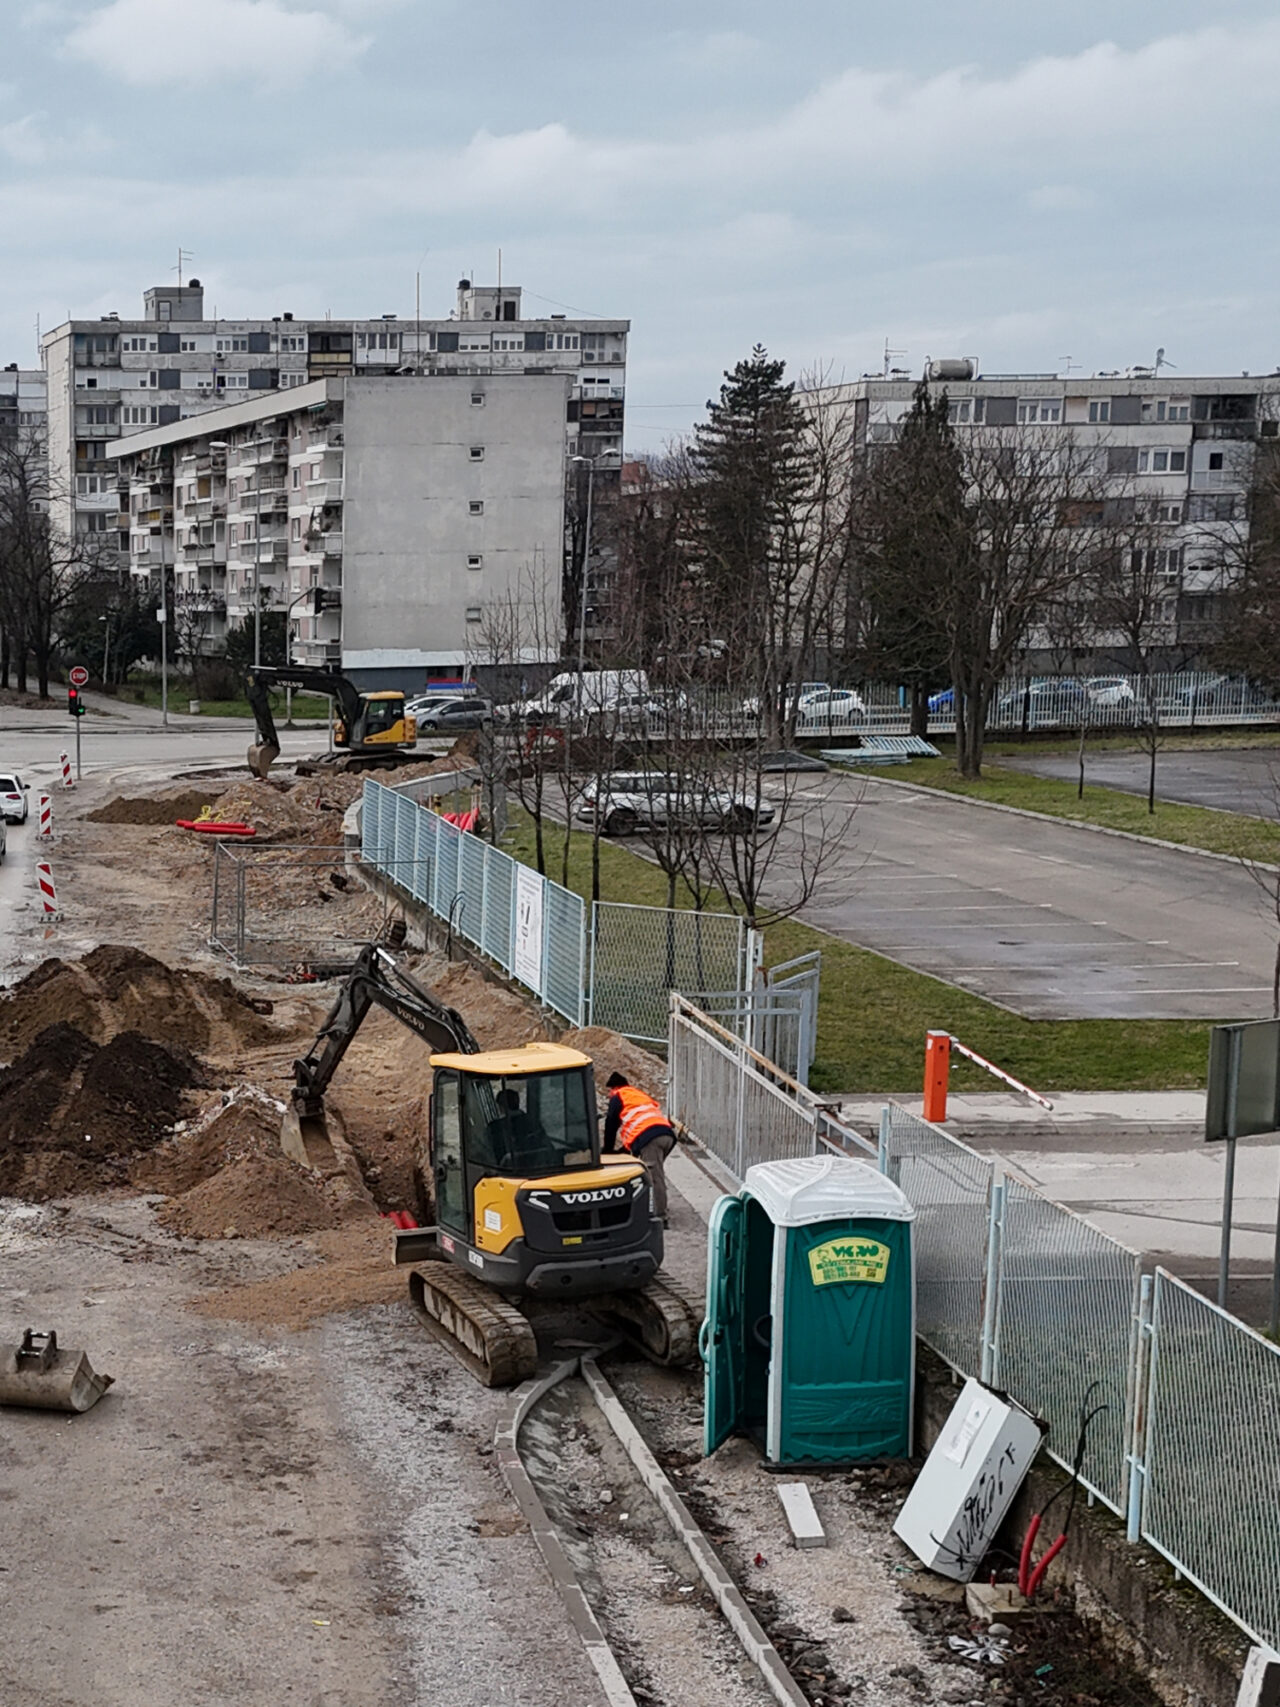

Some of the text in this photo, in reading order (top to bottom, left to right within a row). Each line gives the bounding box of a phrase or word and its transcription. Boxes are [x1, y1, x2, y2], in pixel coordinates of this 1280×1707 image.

[276, 680, 304, 689] VOLVO
[396, 1005, 425, 1030] VOLVO
[561, 1187, 626, 1204] VOLVO
